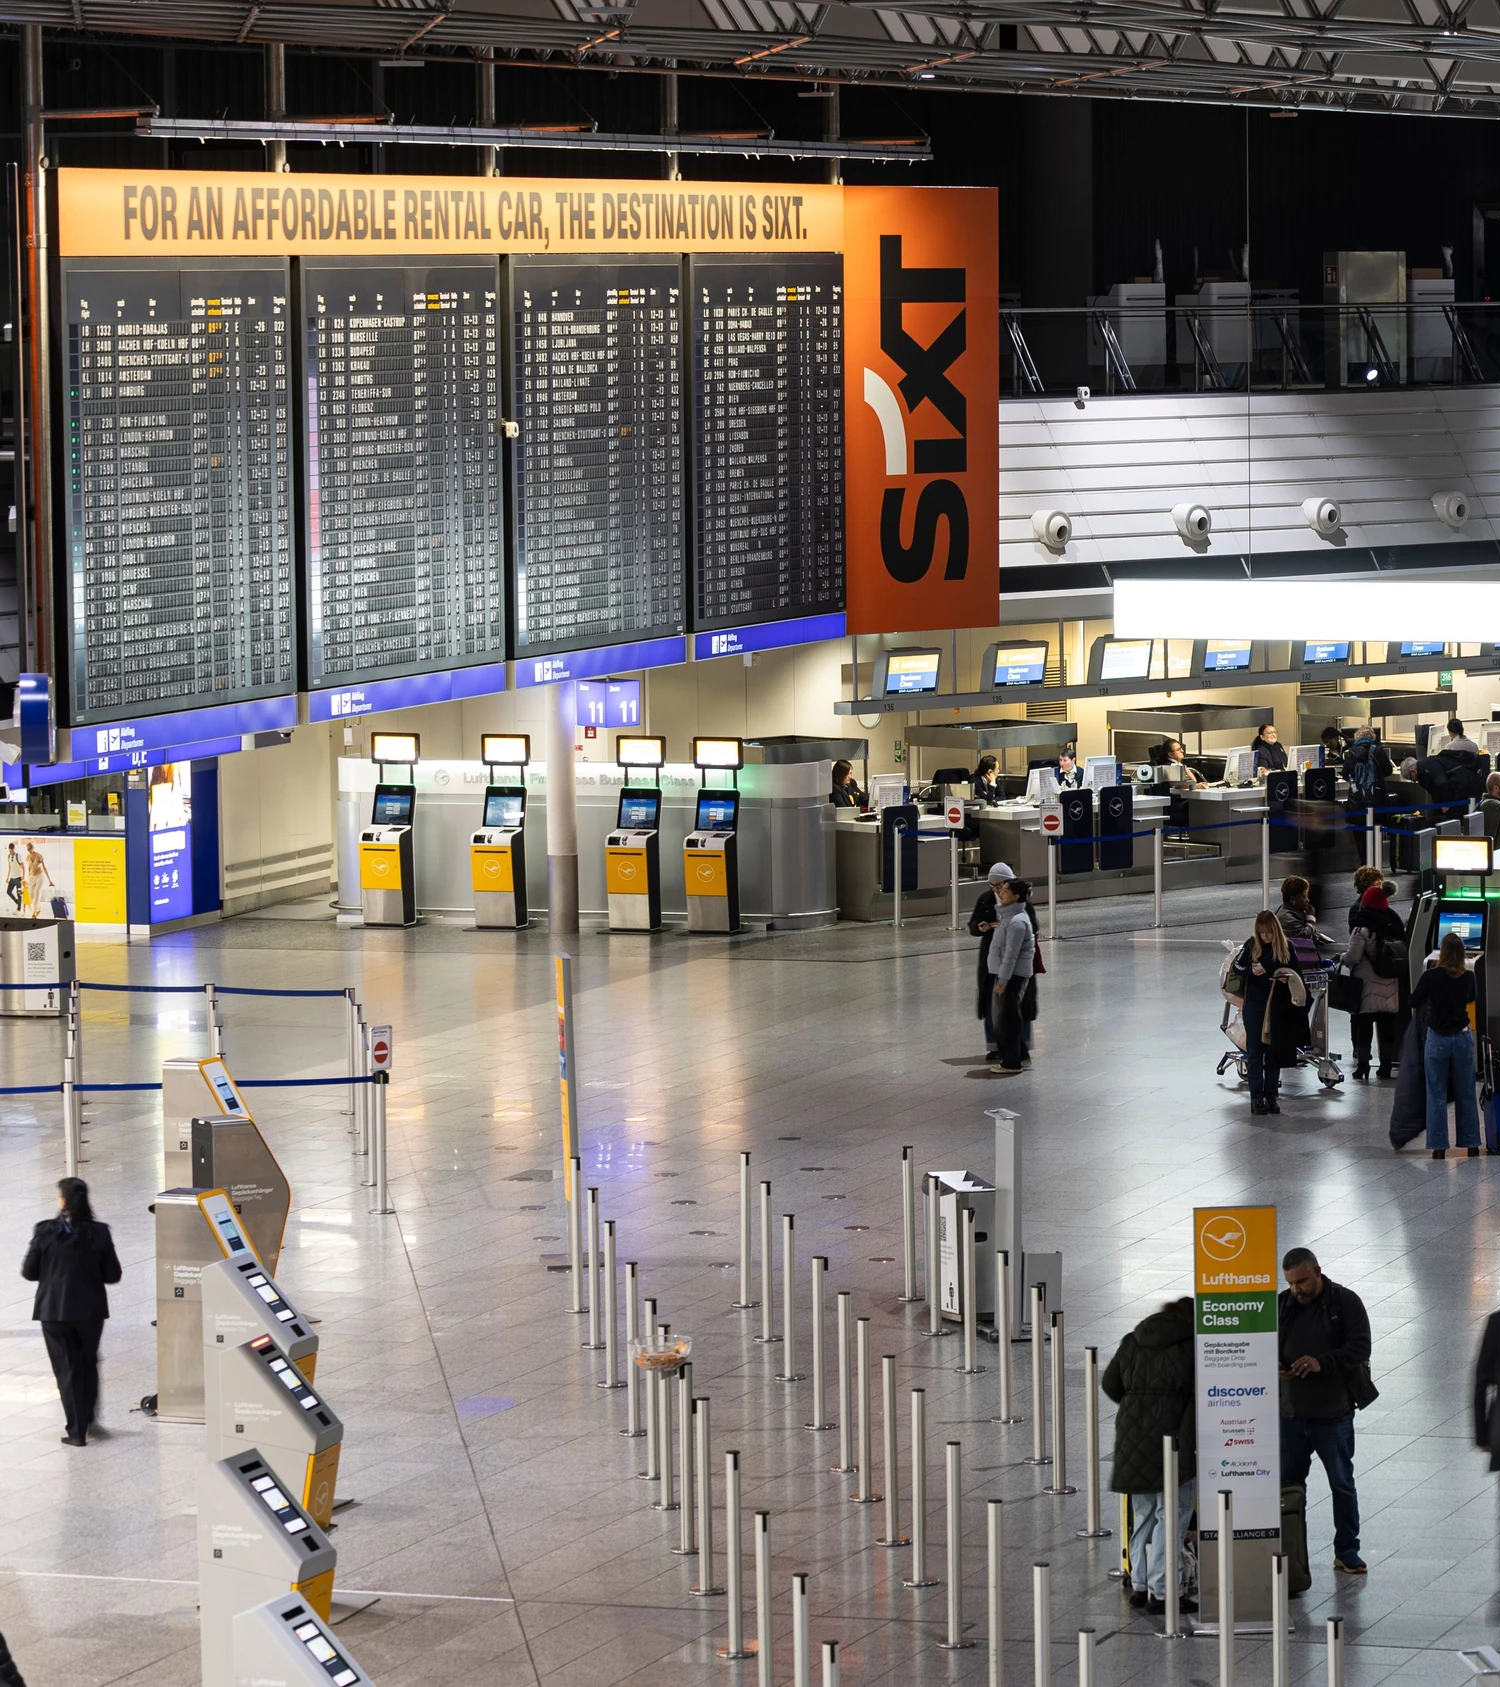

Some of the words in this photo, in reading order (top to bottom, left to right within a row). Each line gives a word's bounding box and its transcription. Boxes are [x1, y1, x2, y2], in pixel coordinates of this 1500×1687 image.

[123, 185, 178, 241] FOR
[186, 187, 223, 240] AN
[232, 187, 397, 241] AFFORDABLE
[404, 189, 491, 240] RENTAL
[499, 190, 550, 250] CAR,
[555, 192, 594, 240] THE
[602, 193, 733, 240] DESTINATION
[739, 195, 757, 240] IS
[762, 195, 807, 240] SIXT.
[97, 325, 111, 336] 1332
[118, 340, 140, 350] AACHEN
[864, 234, 970, 584] SIXT
[1302, 673, 1311, 681] 132
[1442, 672, 1451, 681] 316
[1202, 680, 1211, 688] 133
[1099, 688, 1108, 696] 134
[588, 701, 603, 723] 11
[620, 700, 636, 723] 11
[231, 1188, 274, 1196] Gepäckanhänger
[1202, 1273, 1271, 1285] Lufthansa
[1202, 1300, 1264, 1312] Economy
[1202, 1315, 1240, 1326] Class
[1204, 1341, 1250, 1349] Gepäckabgabe
[1204, 1355, 1230, 1363] Baggage
[1207, 1398, 1241, 1408] airlines
[1256, 1469, 1270, 1477] City
